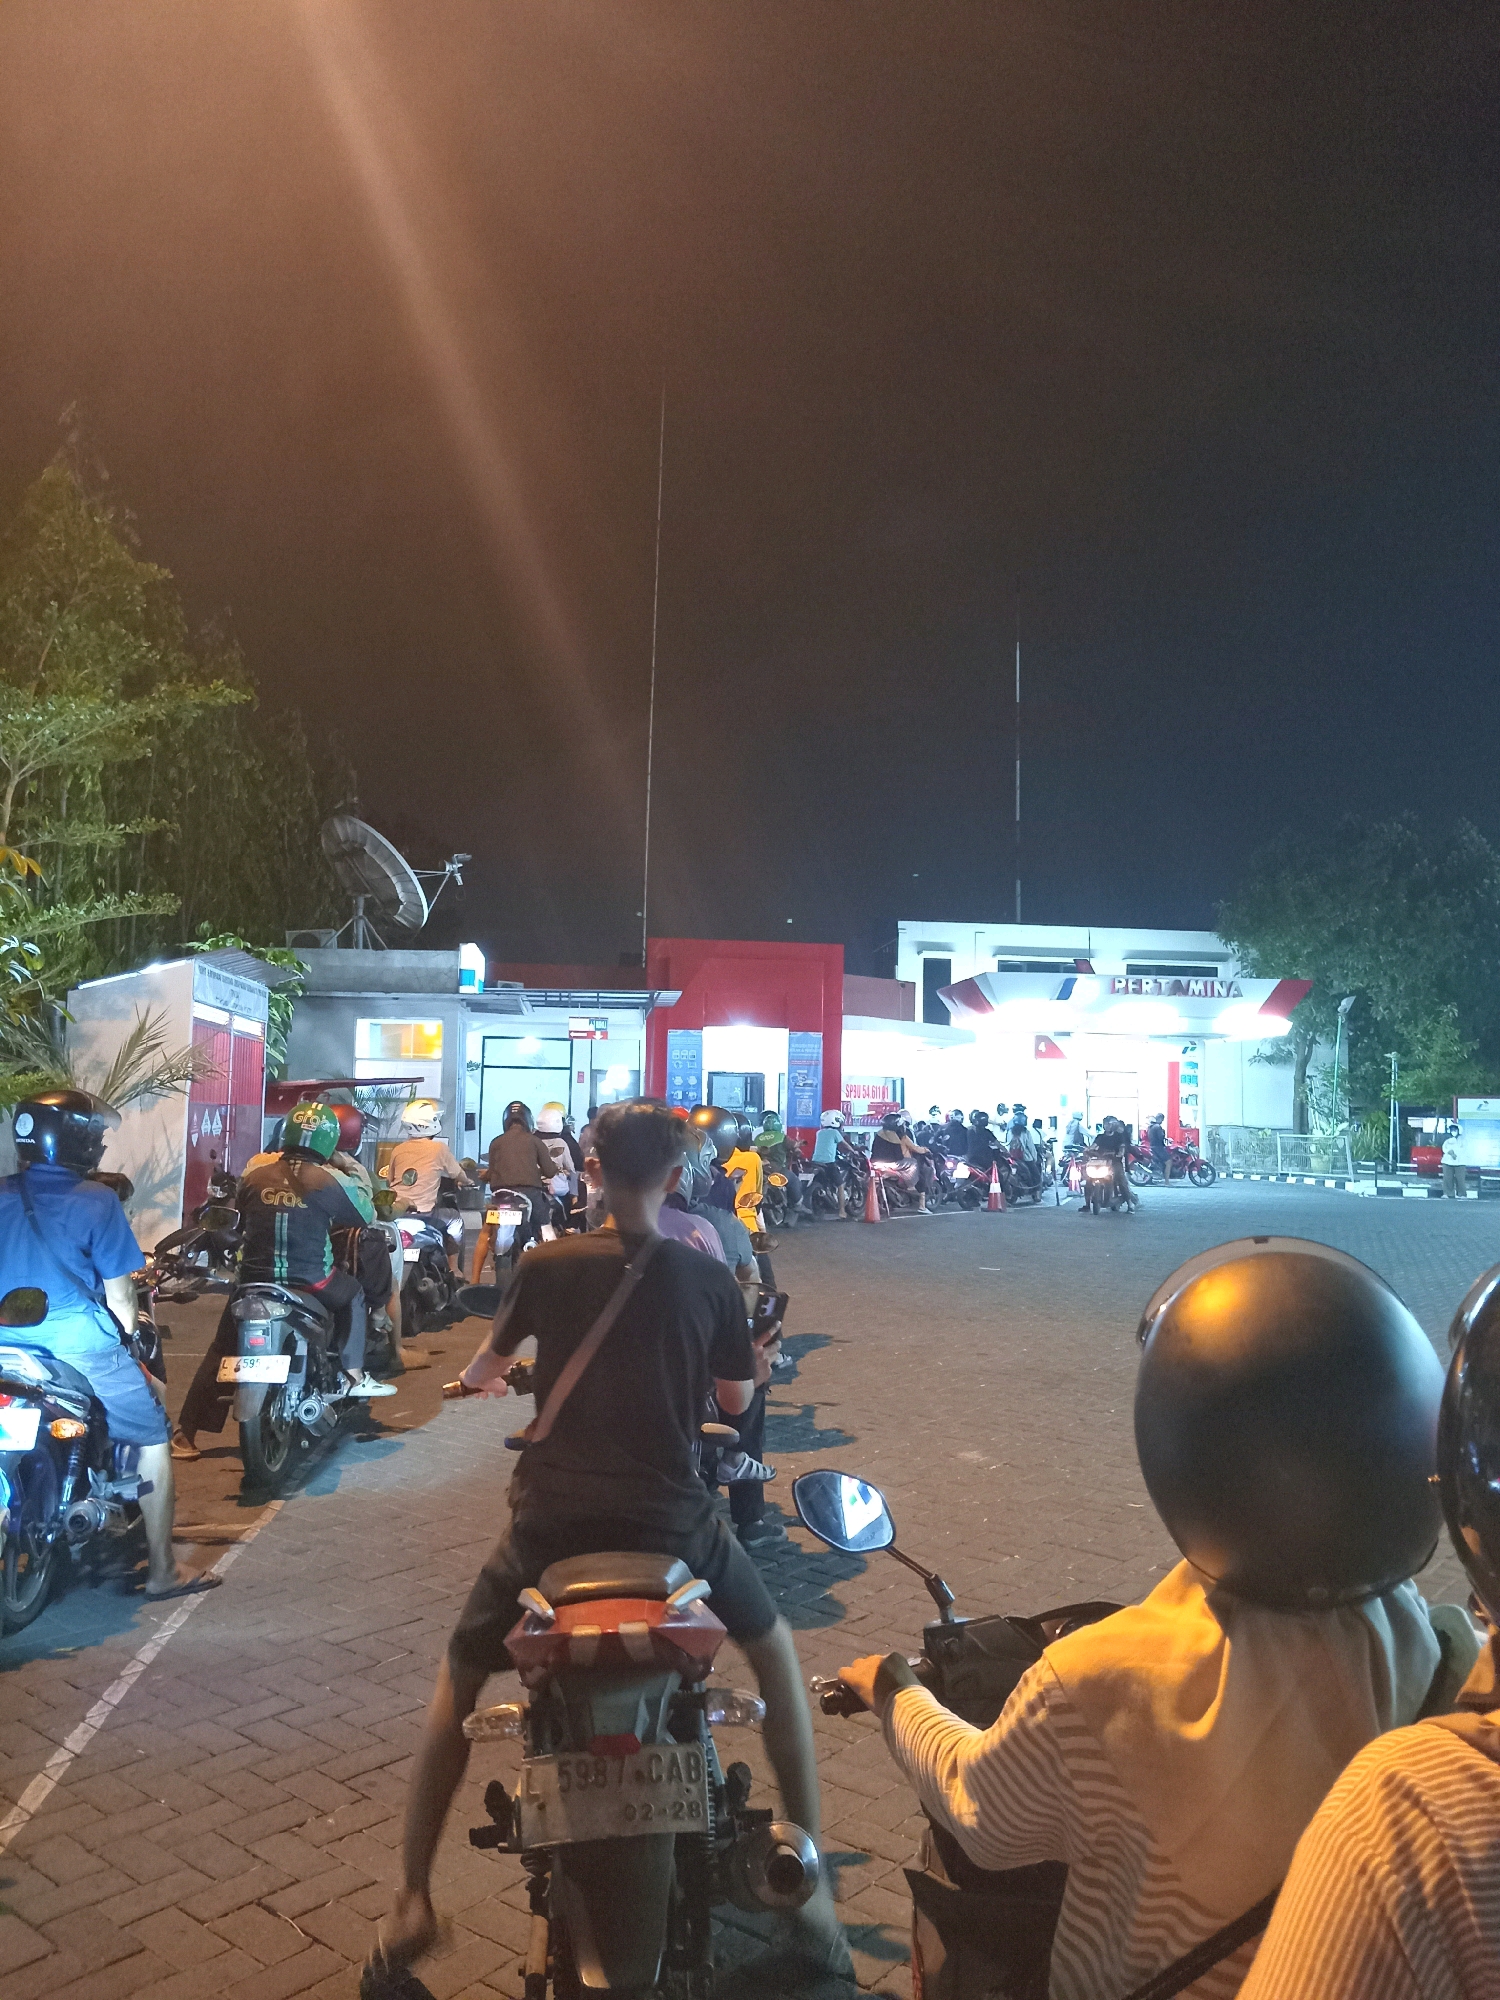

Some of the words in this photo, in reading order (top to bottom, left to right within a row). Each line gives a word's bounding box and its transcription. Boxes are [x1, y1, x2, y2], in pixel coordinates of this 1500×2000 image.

[1110, 977, 1243, 998] PERTAMINA
[1038, 1041, 1046, 1053] 4
[845, 1083, 861, 1099] SPBU
[221, 1358, 228, 1370] L
[525, 1765, 541, 1803] L
[557, 1754, 626, 1793] 5987
[648, 1751, 703, 1785] CAB
